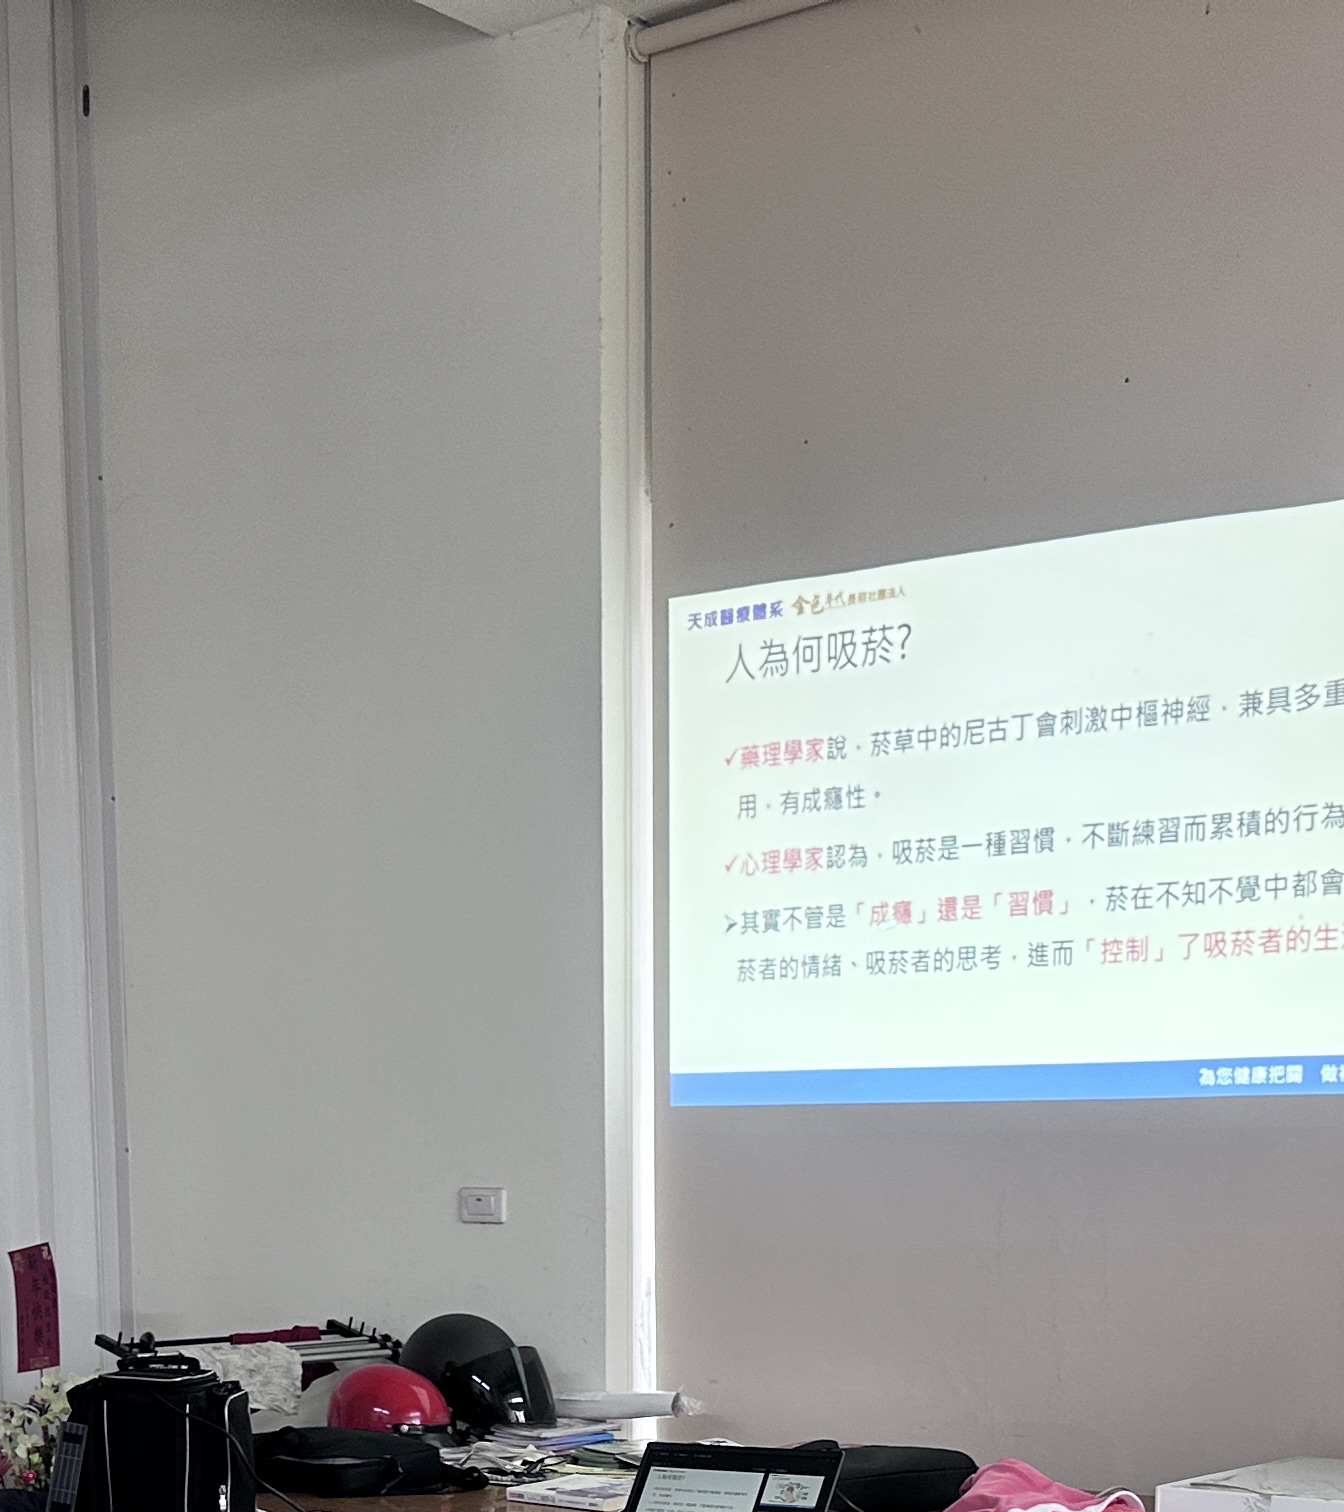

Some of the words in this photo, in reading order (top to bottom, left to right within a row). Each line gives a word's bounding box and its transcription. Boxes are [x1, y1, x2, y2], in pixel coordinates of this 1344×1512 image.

[687, 600, 784, 630] 天成醫療體系
[725, 623, 912, 684] 人為何吸菸?
